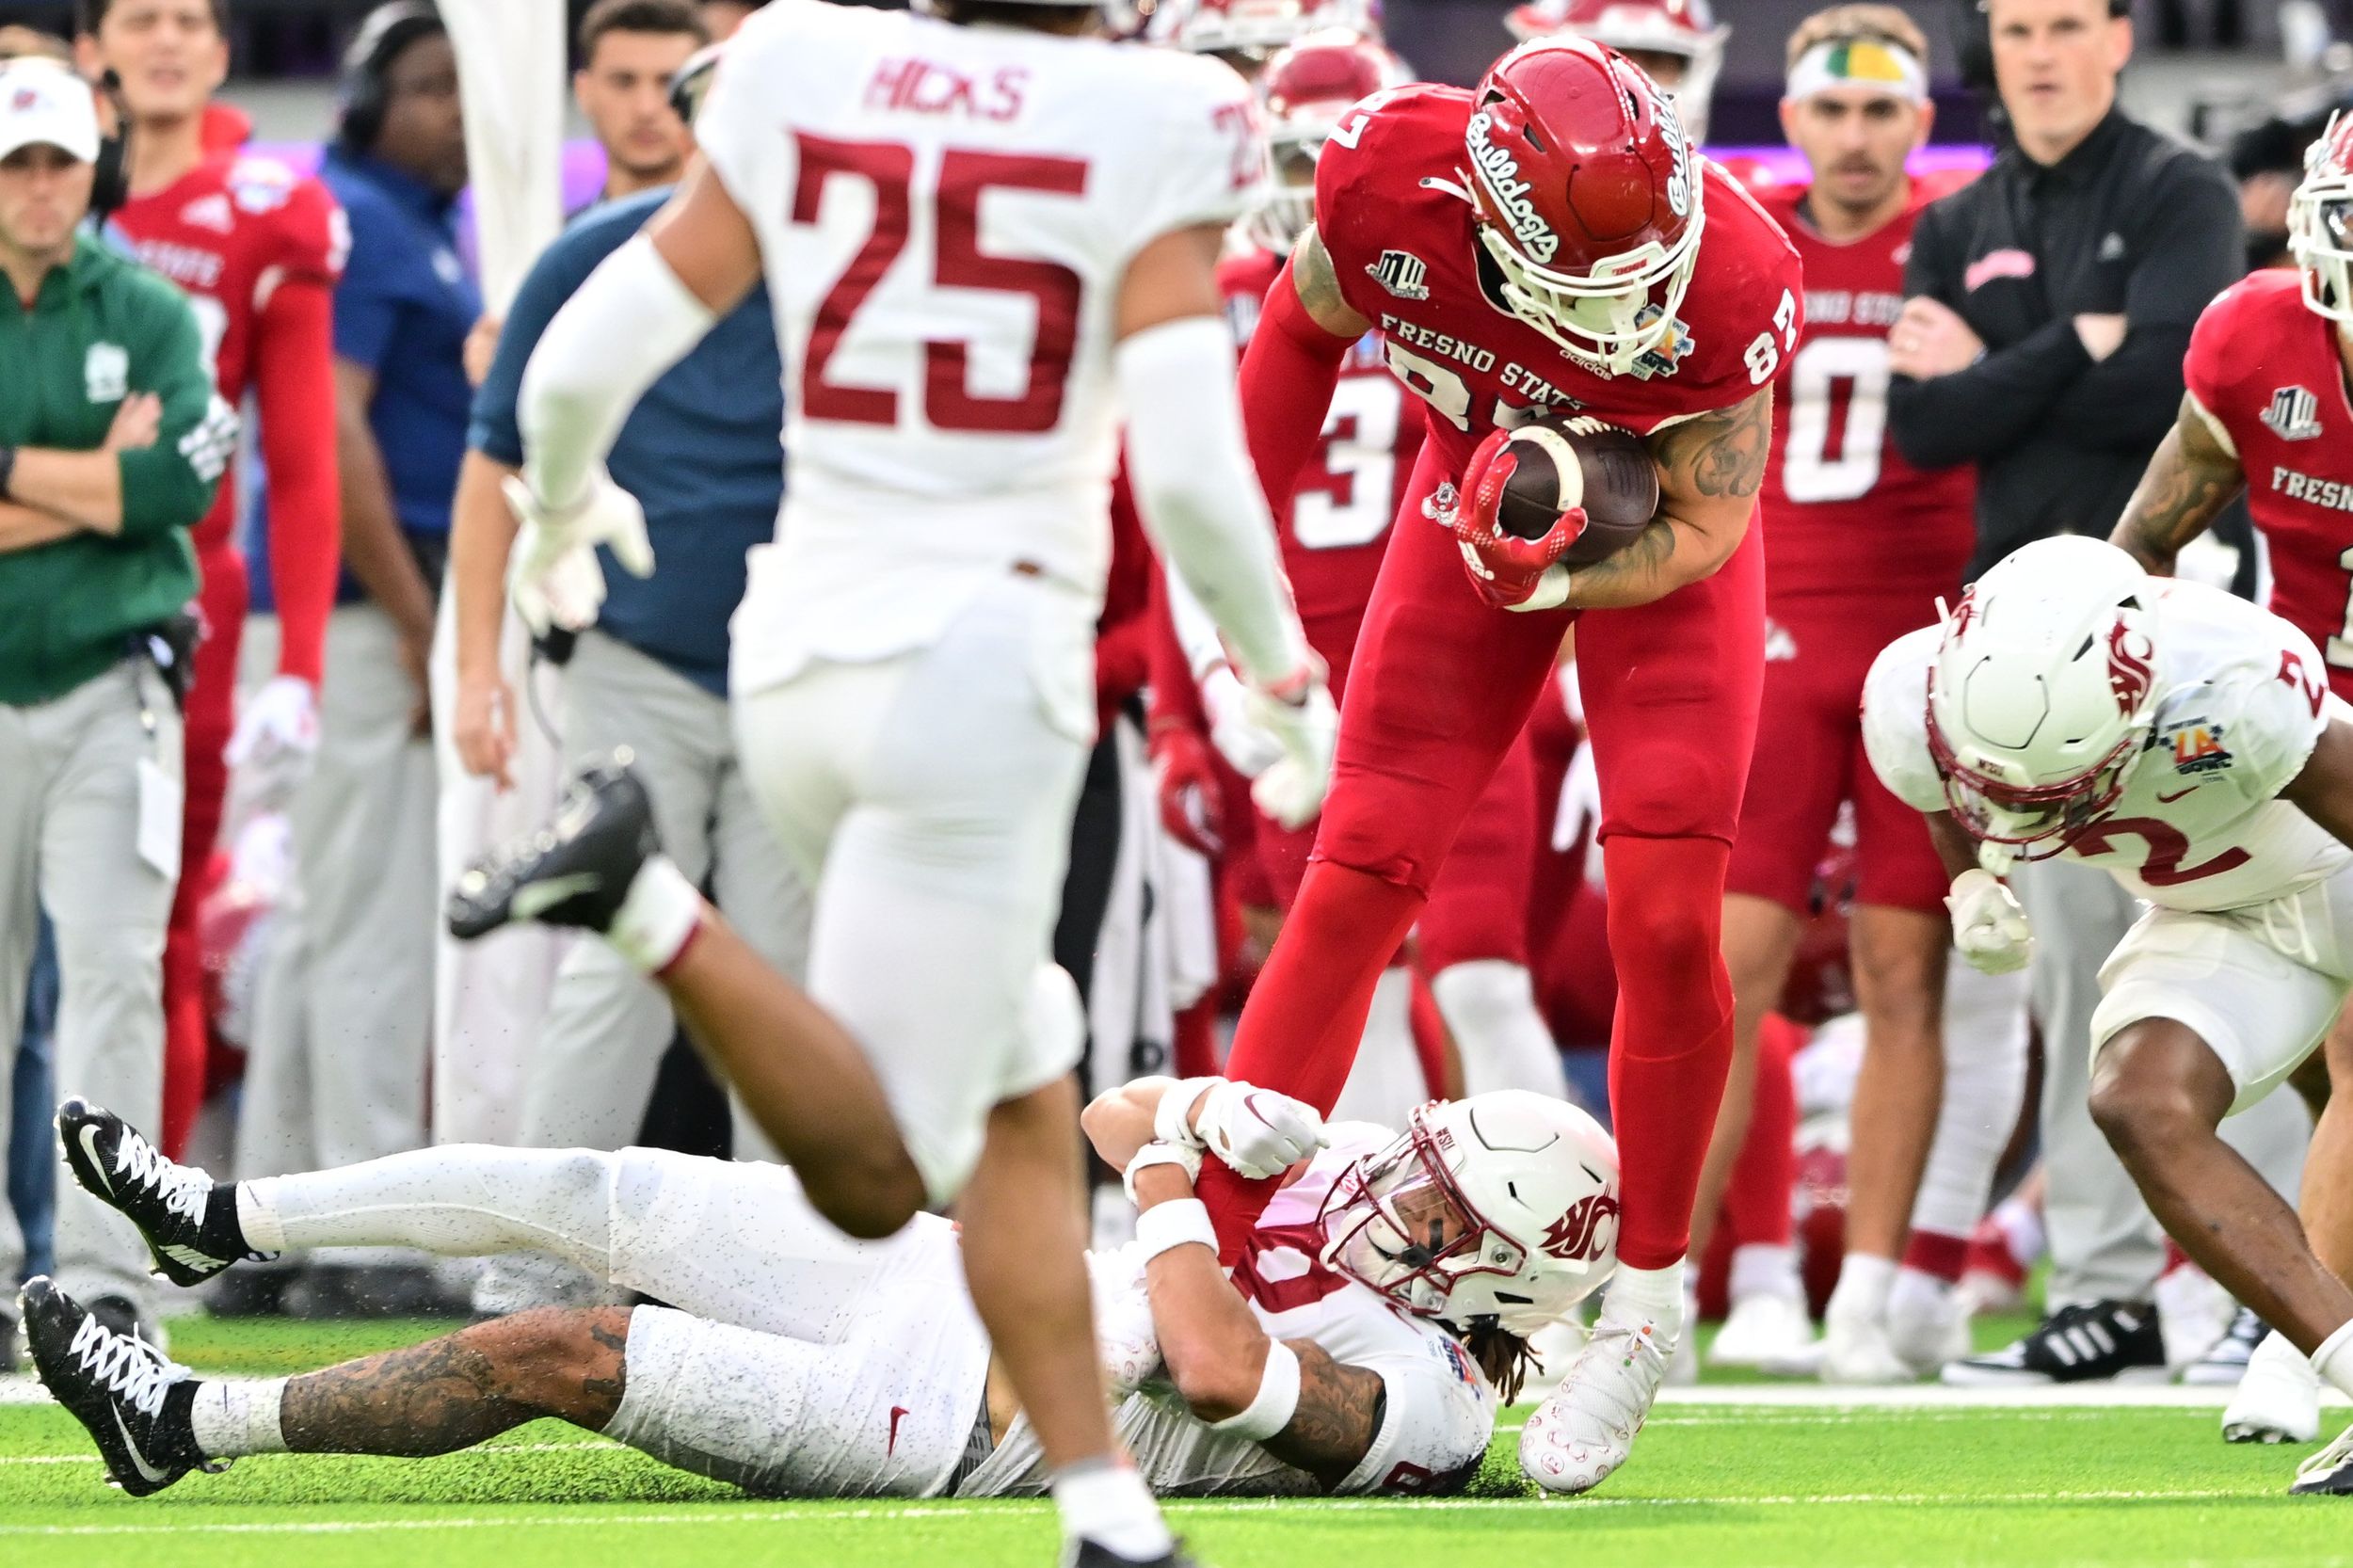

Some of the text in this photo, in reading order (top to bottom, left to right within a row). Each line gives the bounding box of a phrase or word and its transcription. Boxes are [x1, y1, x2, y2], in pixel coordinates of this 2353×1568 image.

[861, 56, 1032, 123] HICKS
[1466, 112, 1559, 264] Bulldogs
[792, 132, 1090, 432] 25
[1380, 312, 1497, 375] FRESNO
[1559, 348, 1613, 381] adidas
[1743, 287, 1798, 386] 87
[1783, 336, 1891, 503] 0
[1294, 376, 1401, 550] 3
[2275, 648, 2329, 720] 2
[2057, 816, 2253, 888] 2
